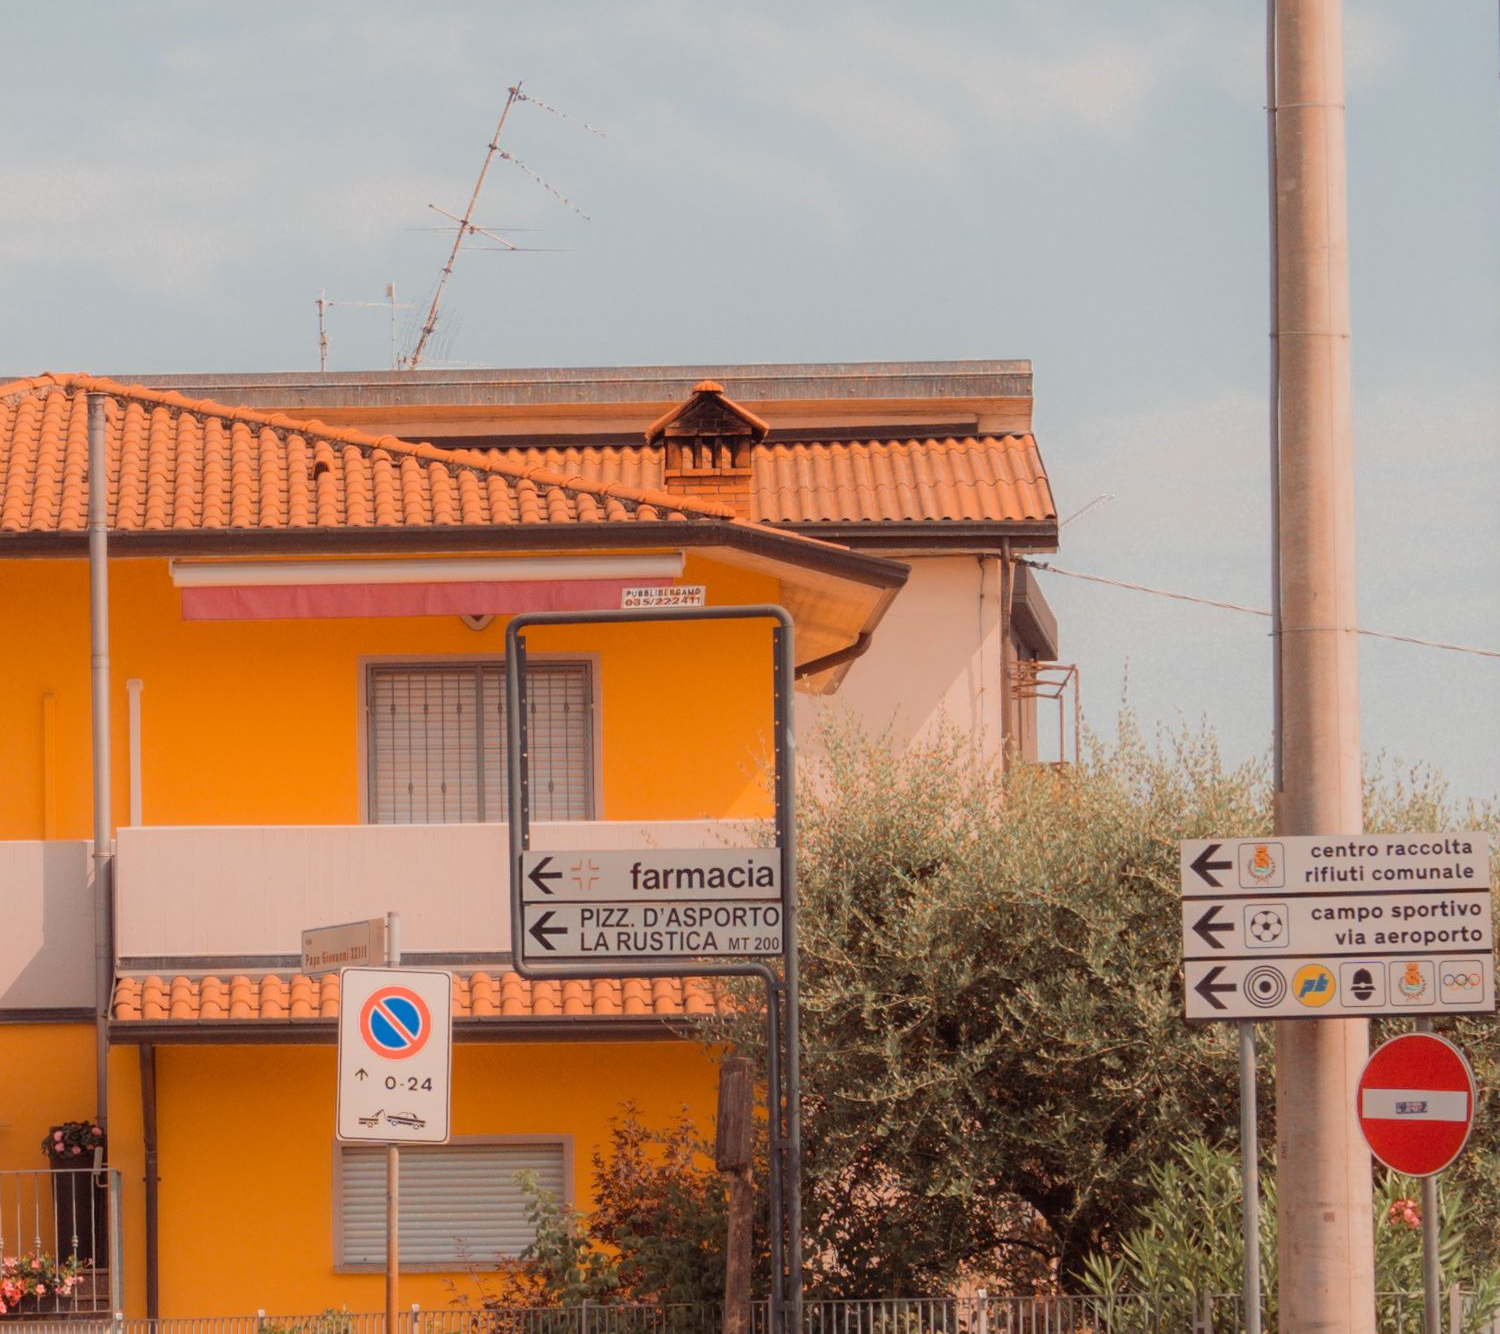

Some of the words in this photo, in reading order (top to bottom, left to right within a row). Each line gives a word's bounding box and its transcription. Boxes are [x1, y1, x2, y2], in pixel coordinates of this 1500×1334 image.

[625, 596, 700, 606] 035/222411
[626, 588, 701, 597] PUBBLIBERGAMO
[1311, 842, 1379, 859] centro
[1386, 838, 1472, 855] raccolta
[630, 860, 775, 890] farmacia
[1305, 864, 1364, 882] rifiuti
[1372, 862, 1474, 880] comunale
[580, 908, 635, 928] PIZZ.
[643, 906, 780, 928] D'ASPORTO
[1311, 905, 1383, 922] campo
[1391, 901, 1481, 920] sportivo
[580, 932, 611, 951] LA
[617, 931, 719, 951] RUSTICA
[728, 937, 750, 951] MT
[754, 936, 780, 951] 200
[1335, 929, 1366, 946] via
[1375, 927, 1482, 946] aeroporto
[305, 954, 320, 969] Papa
[321, 950, 349, 964] Giovanni
[351, 945, 367, 961] XXIII
